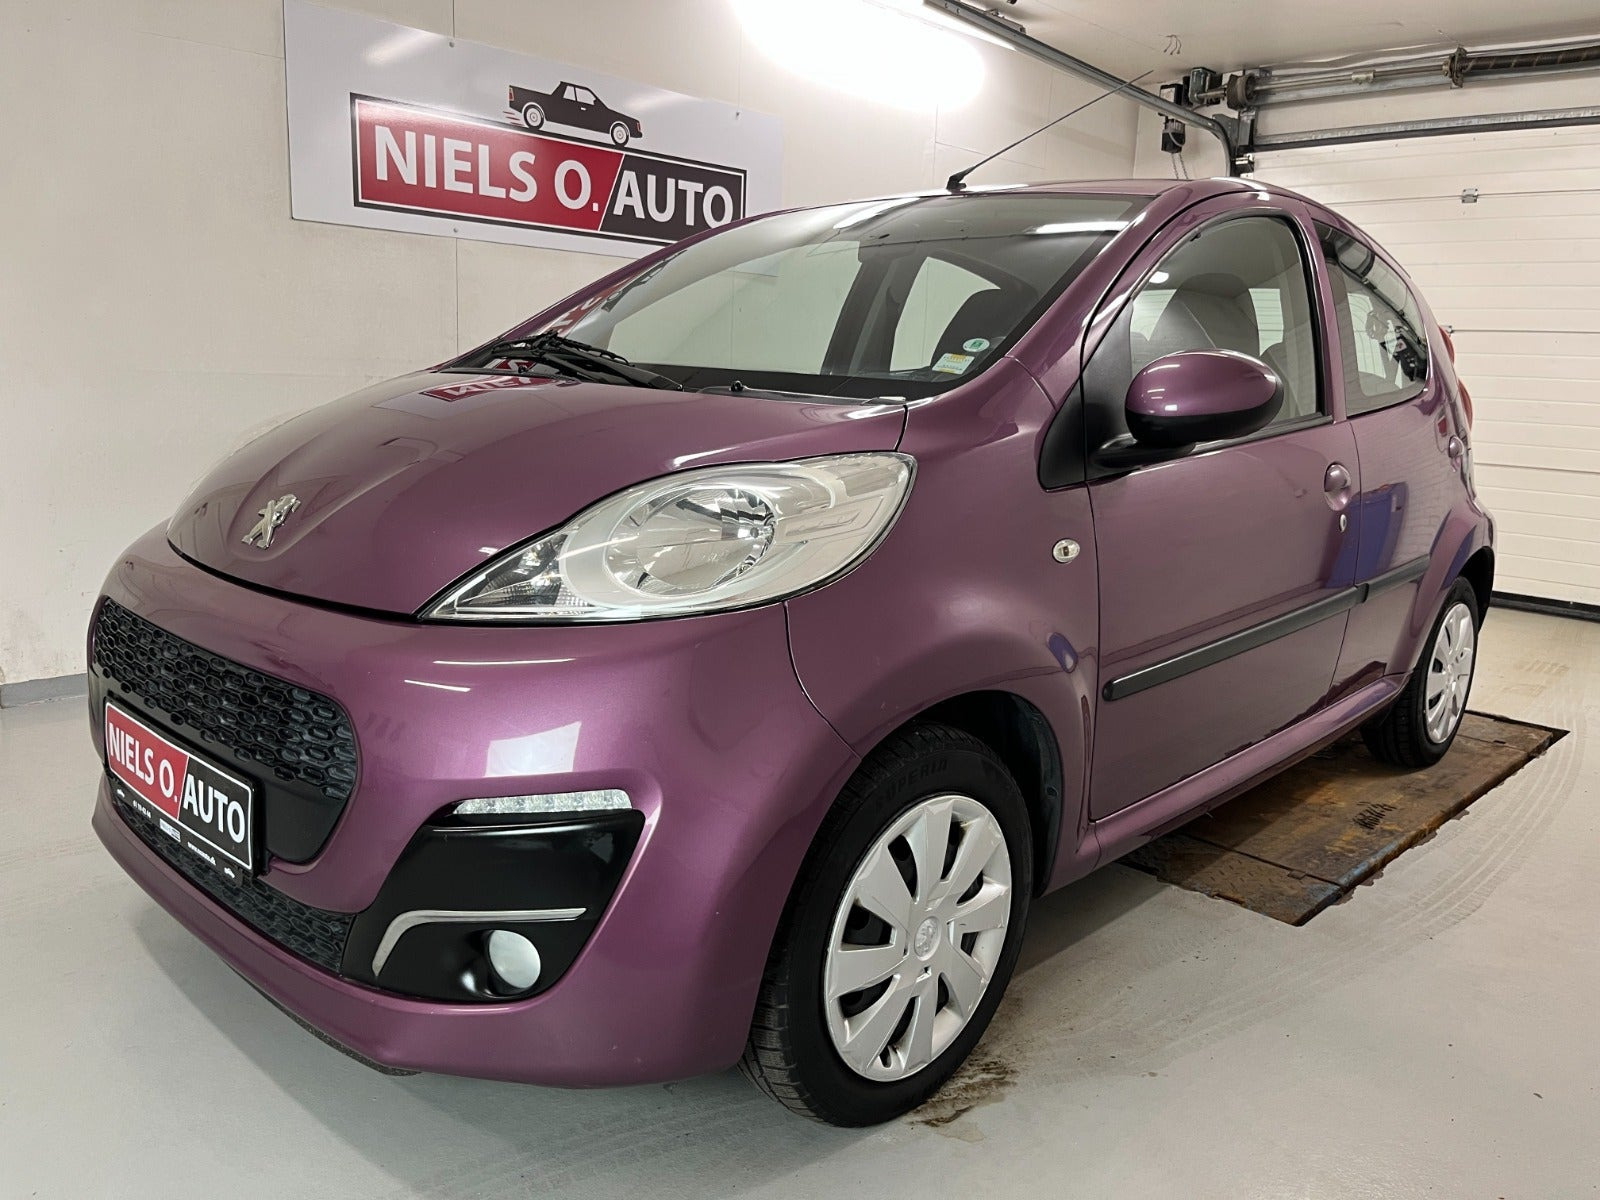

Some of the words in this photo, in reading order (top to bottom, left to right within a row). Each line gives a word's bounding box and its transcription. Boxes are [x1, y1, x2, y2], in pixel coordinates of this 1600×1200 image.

[375, 125, 538, 203] NIELS
[554, 159, 599, 212] O.
[613, 170, 734, 229] AUTO
[108, 723, 155, 786] NIELS
[159, 759, 178, 803] O.
[183, 773, 246, 844] AUTO
